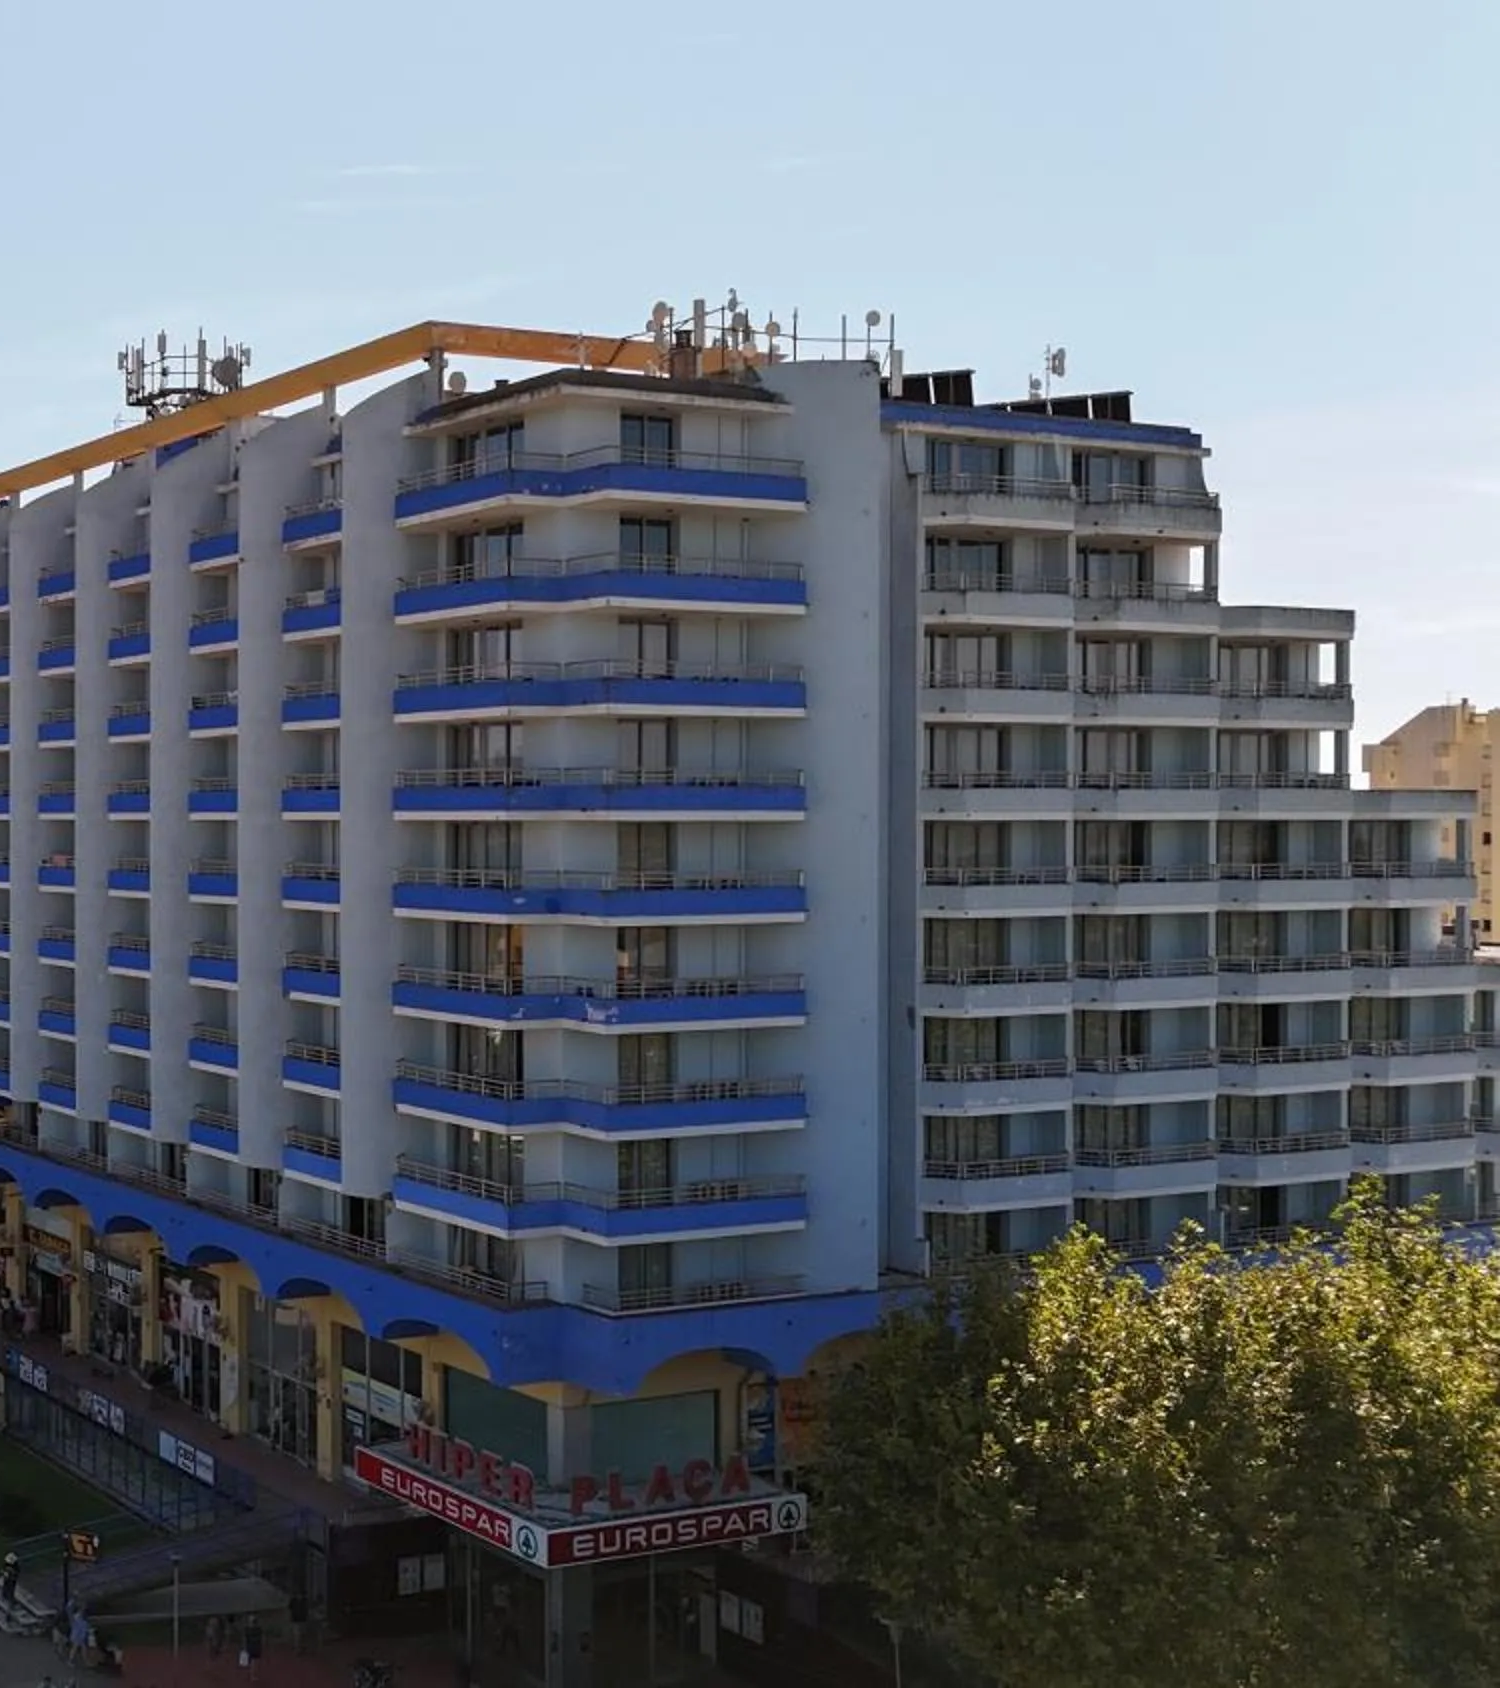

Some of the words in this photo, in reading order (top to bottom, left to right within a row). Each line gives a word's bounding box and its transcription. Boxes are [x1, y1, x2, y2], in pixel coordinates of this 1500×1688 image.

[407, 1422, 534, 1510] HIPER
[380, 1468, 511, 1540] EUROSPAR
[573, 1508, 770, 1558] EUROSPAR
